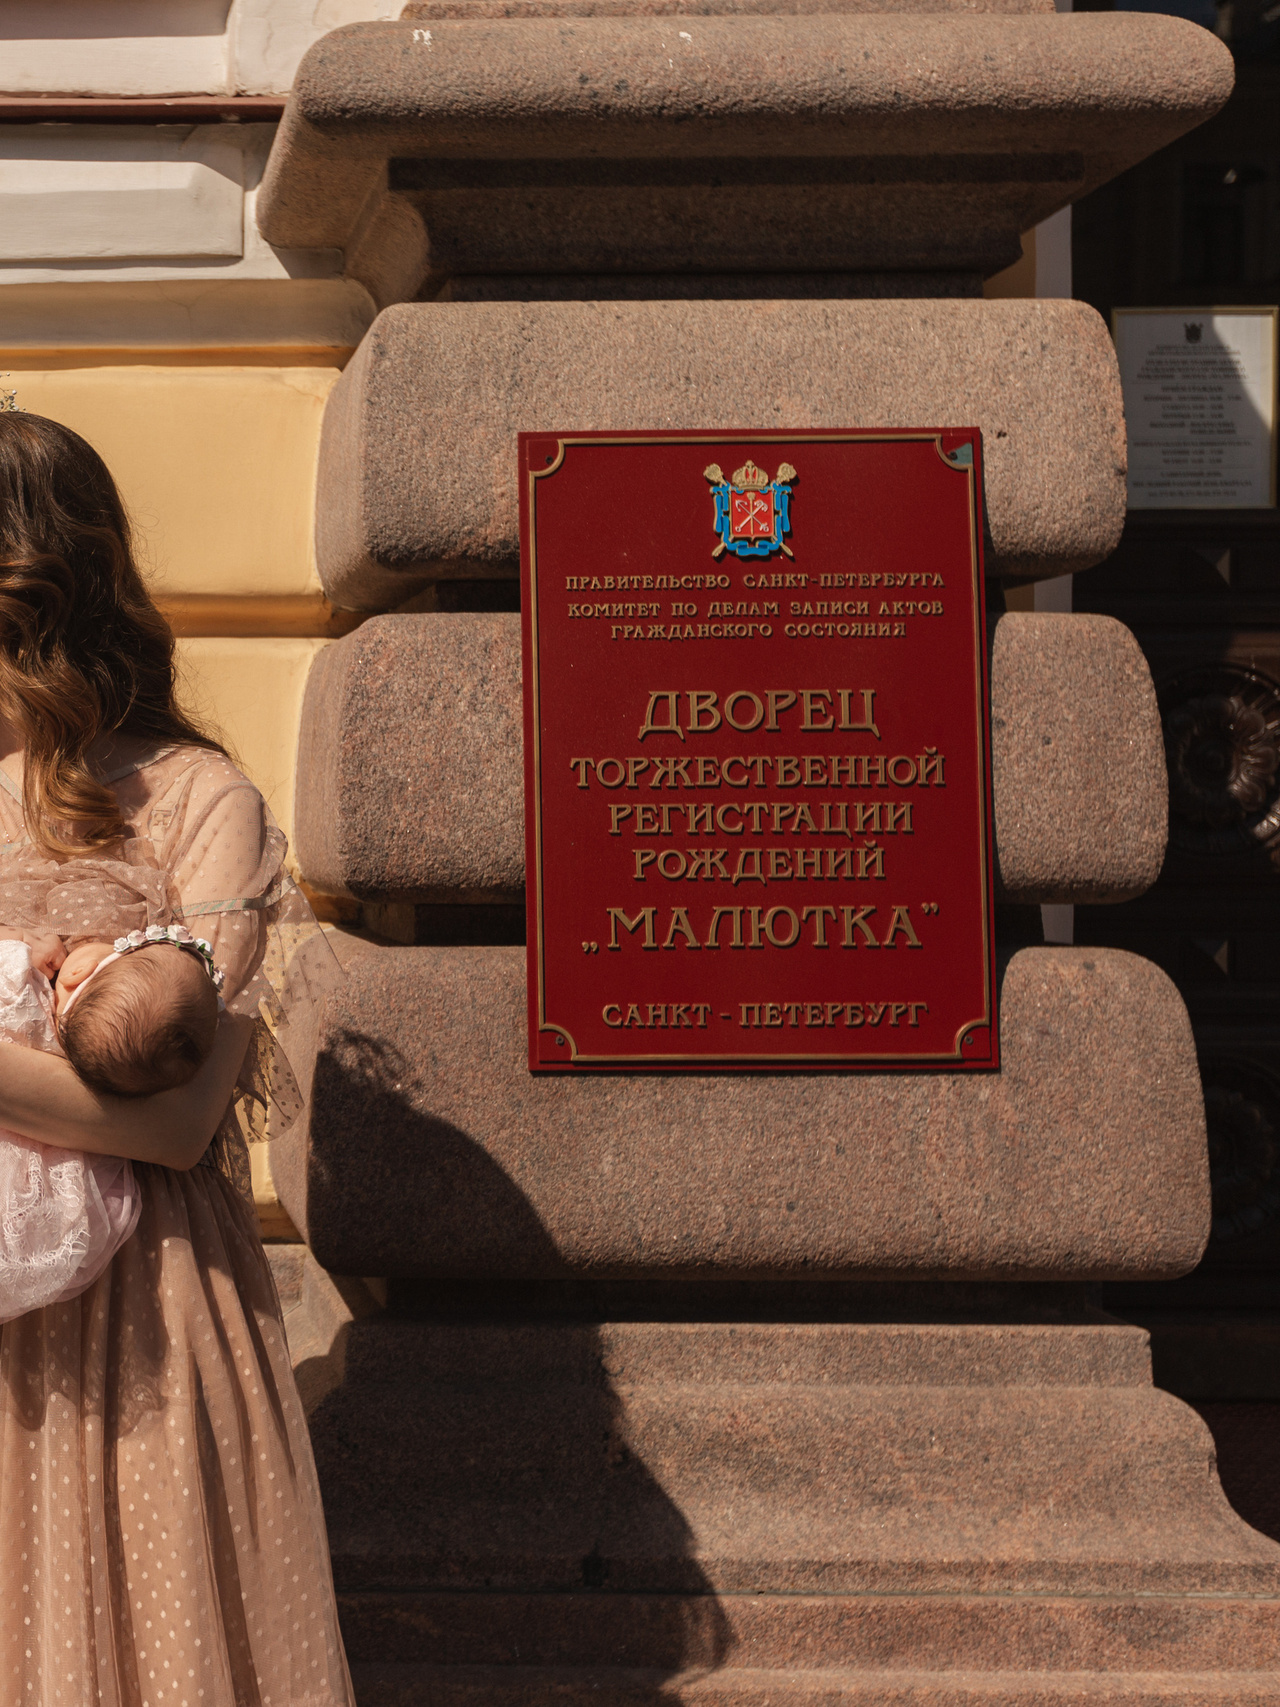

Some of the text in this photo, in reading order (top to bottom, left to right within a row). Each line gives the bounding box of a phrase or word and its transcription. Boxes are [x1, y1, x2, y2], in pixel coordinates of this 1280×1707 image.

[565, 572, 945, 591] ПРАВИТЕЛЬСТВО САНКТ-ПЕТЕРБУРГА
[568, 600, 944, 619] КОМИТЕТ ПО ДЕЛАМ ЗАПИСИ АКТОВ
[611, 622, 907, 641] ГРАЖДАНСКОГО СОСТОЯНИЯ
[638, 689, 880, 741] ДВОРЕЦ
[570, 747, 946, 788] ТОРЖЕСТВЕННОЙ
[608, 802, 914, 840] РЕГИСТРАЦИИ
[632, 840, 886, 886] РОЖДЕНИЙ
